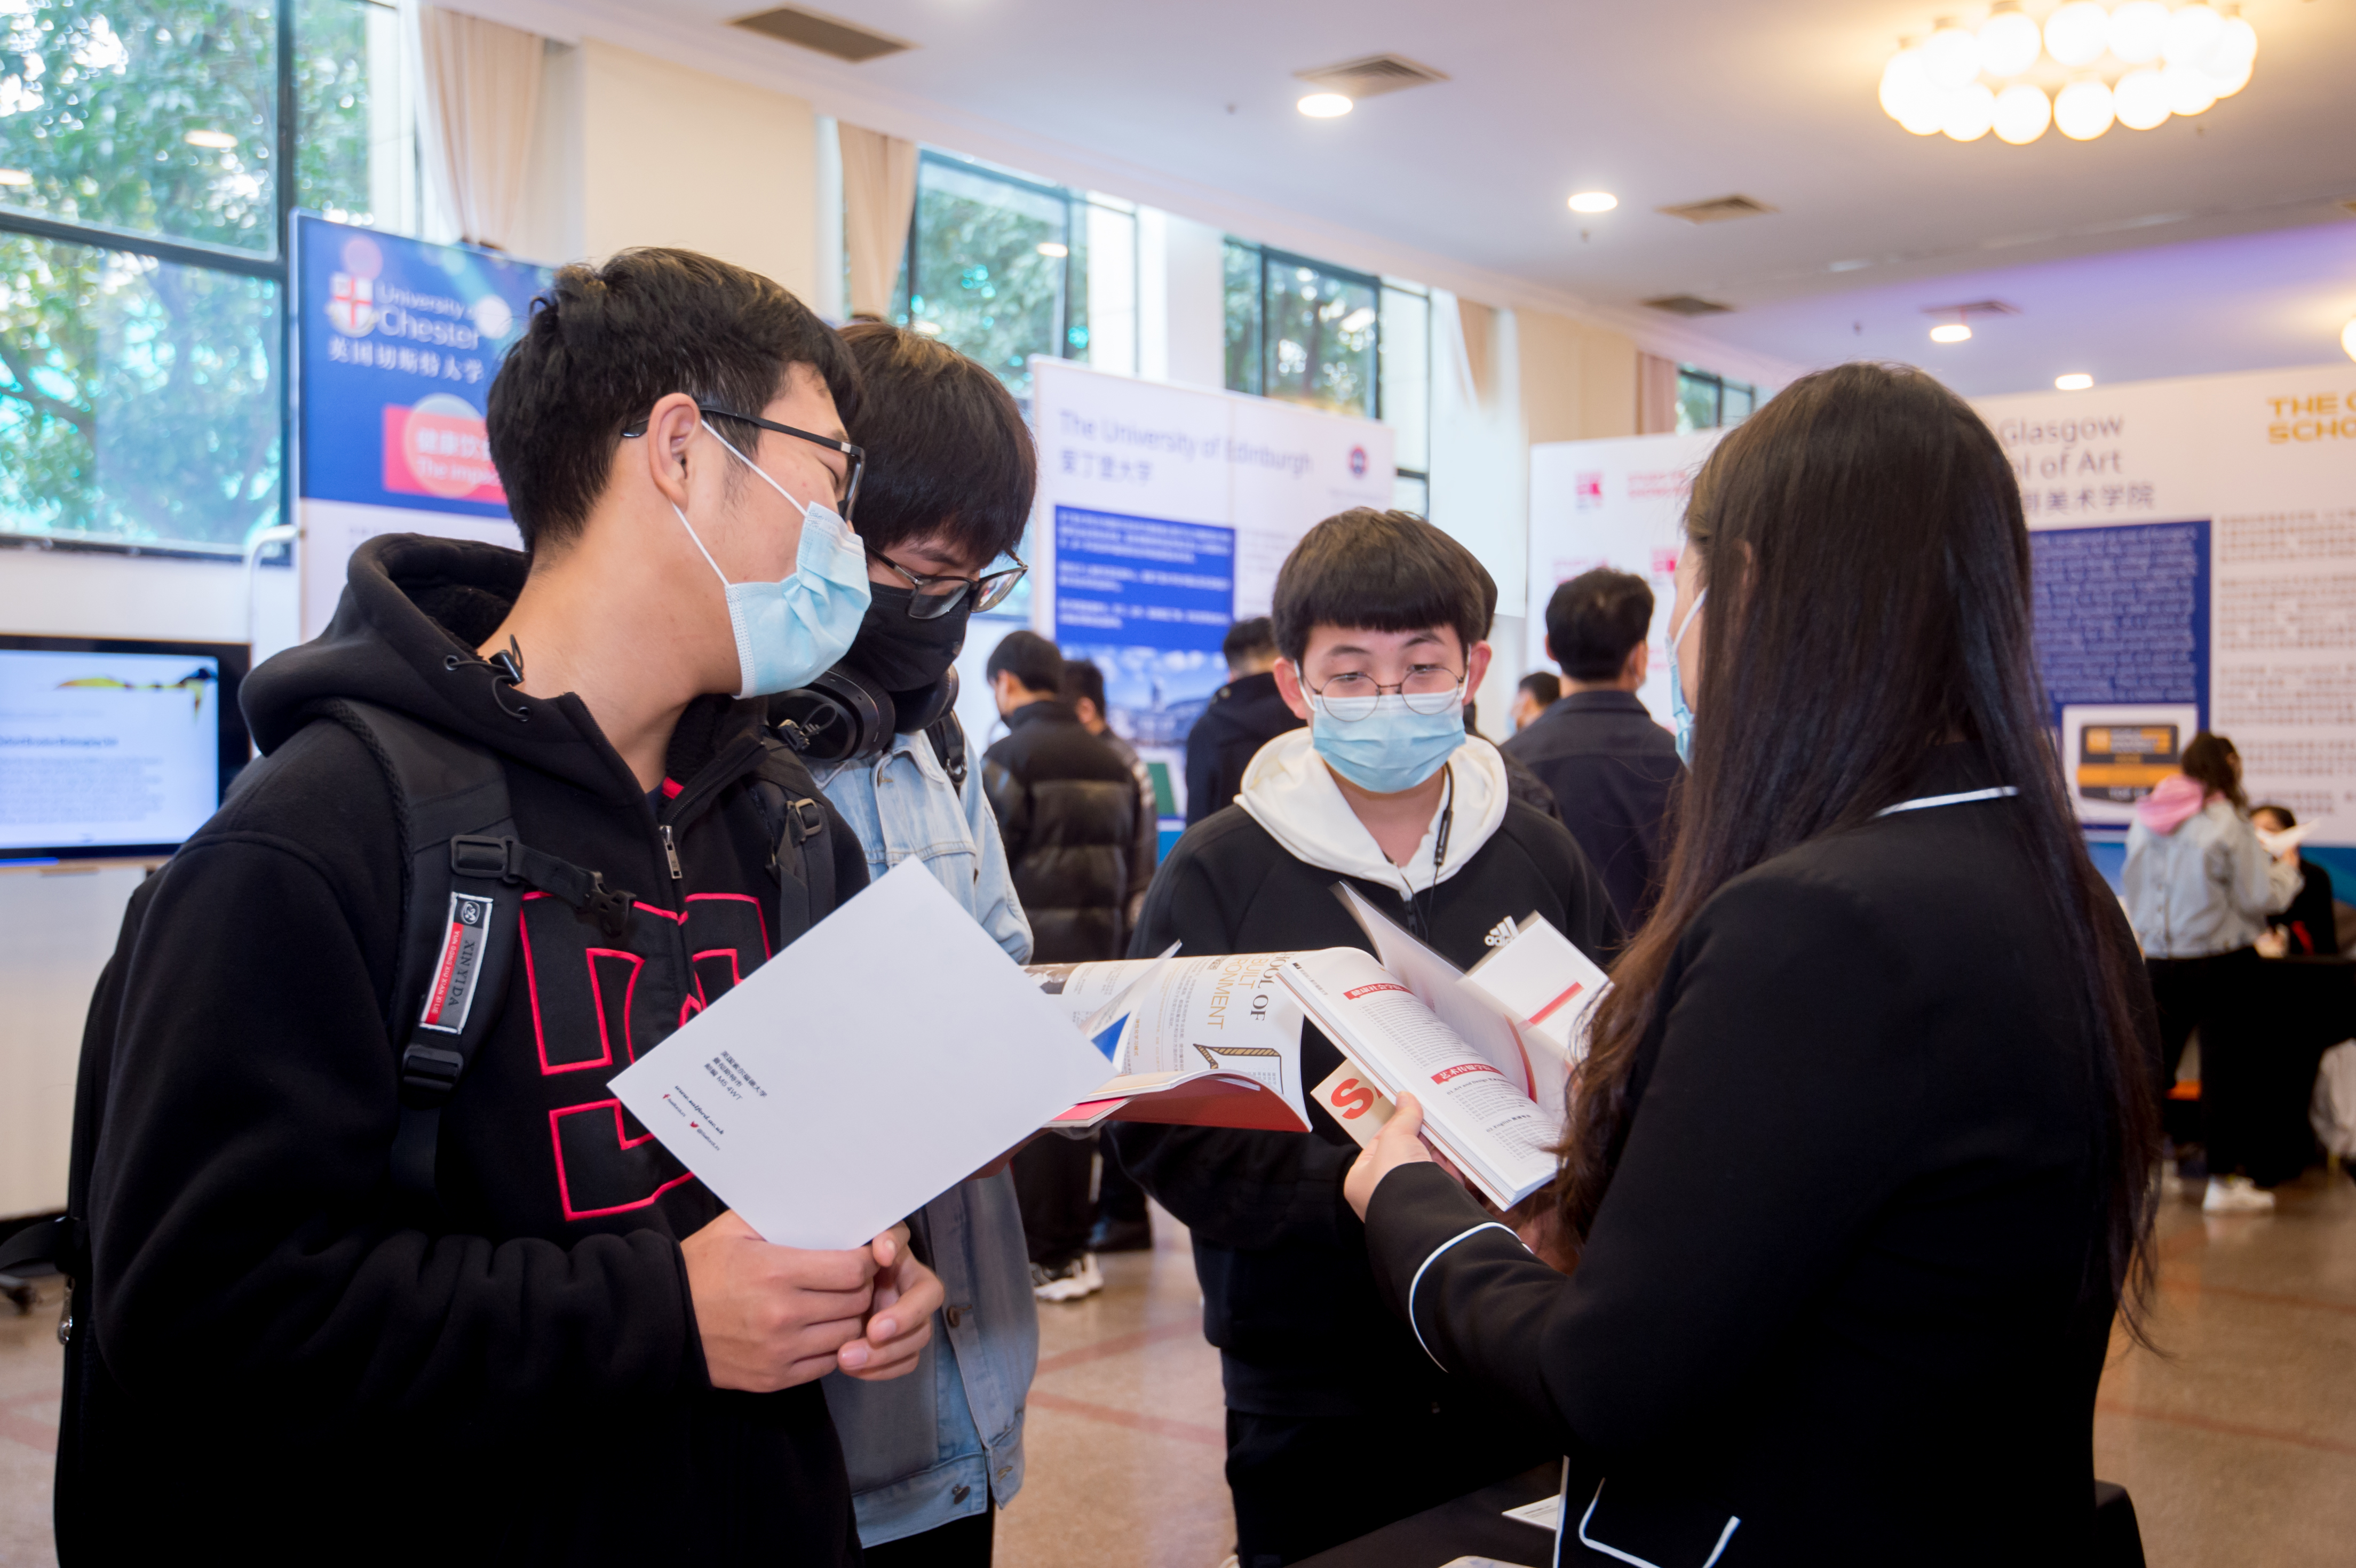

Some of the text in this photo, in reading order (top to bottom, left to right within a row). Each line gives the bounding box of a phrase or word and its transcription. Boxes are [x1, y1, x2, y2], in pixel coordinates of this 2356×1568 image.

[378, 283, 465, 319] University
[378, 304, 480, 350] Chester
[2266, 392, 2338, 418] THE
[1059, 408, 1314, 483] The University of Edinburgh
[1999, 415, 2125, 450] Glasgow
[2039, 450, 2070, 480] of
[2077, 449, 2123, 476] Art
[1238, 958, 1269, 990] BUILT
[1250, 994, 1269, 1021] OF
[717, 1076, 728, 1087] M5
[726, 1085, 743, 1101] 4WT
[1331, 1078, 1384, 1119] S
